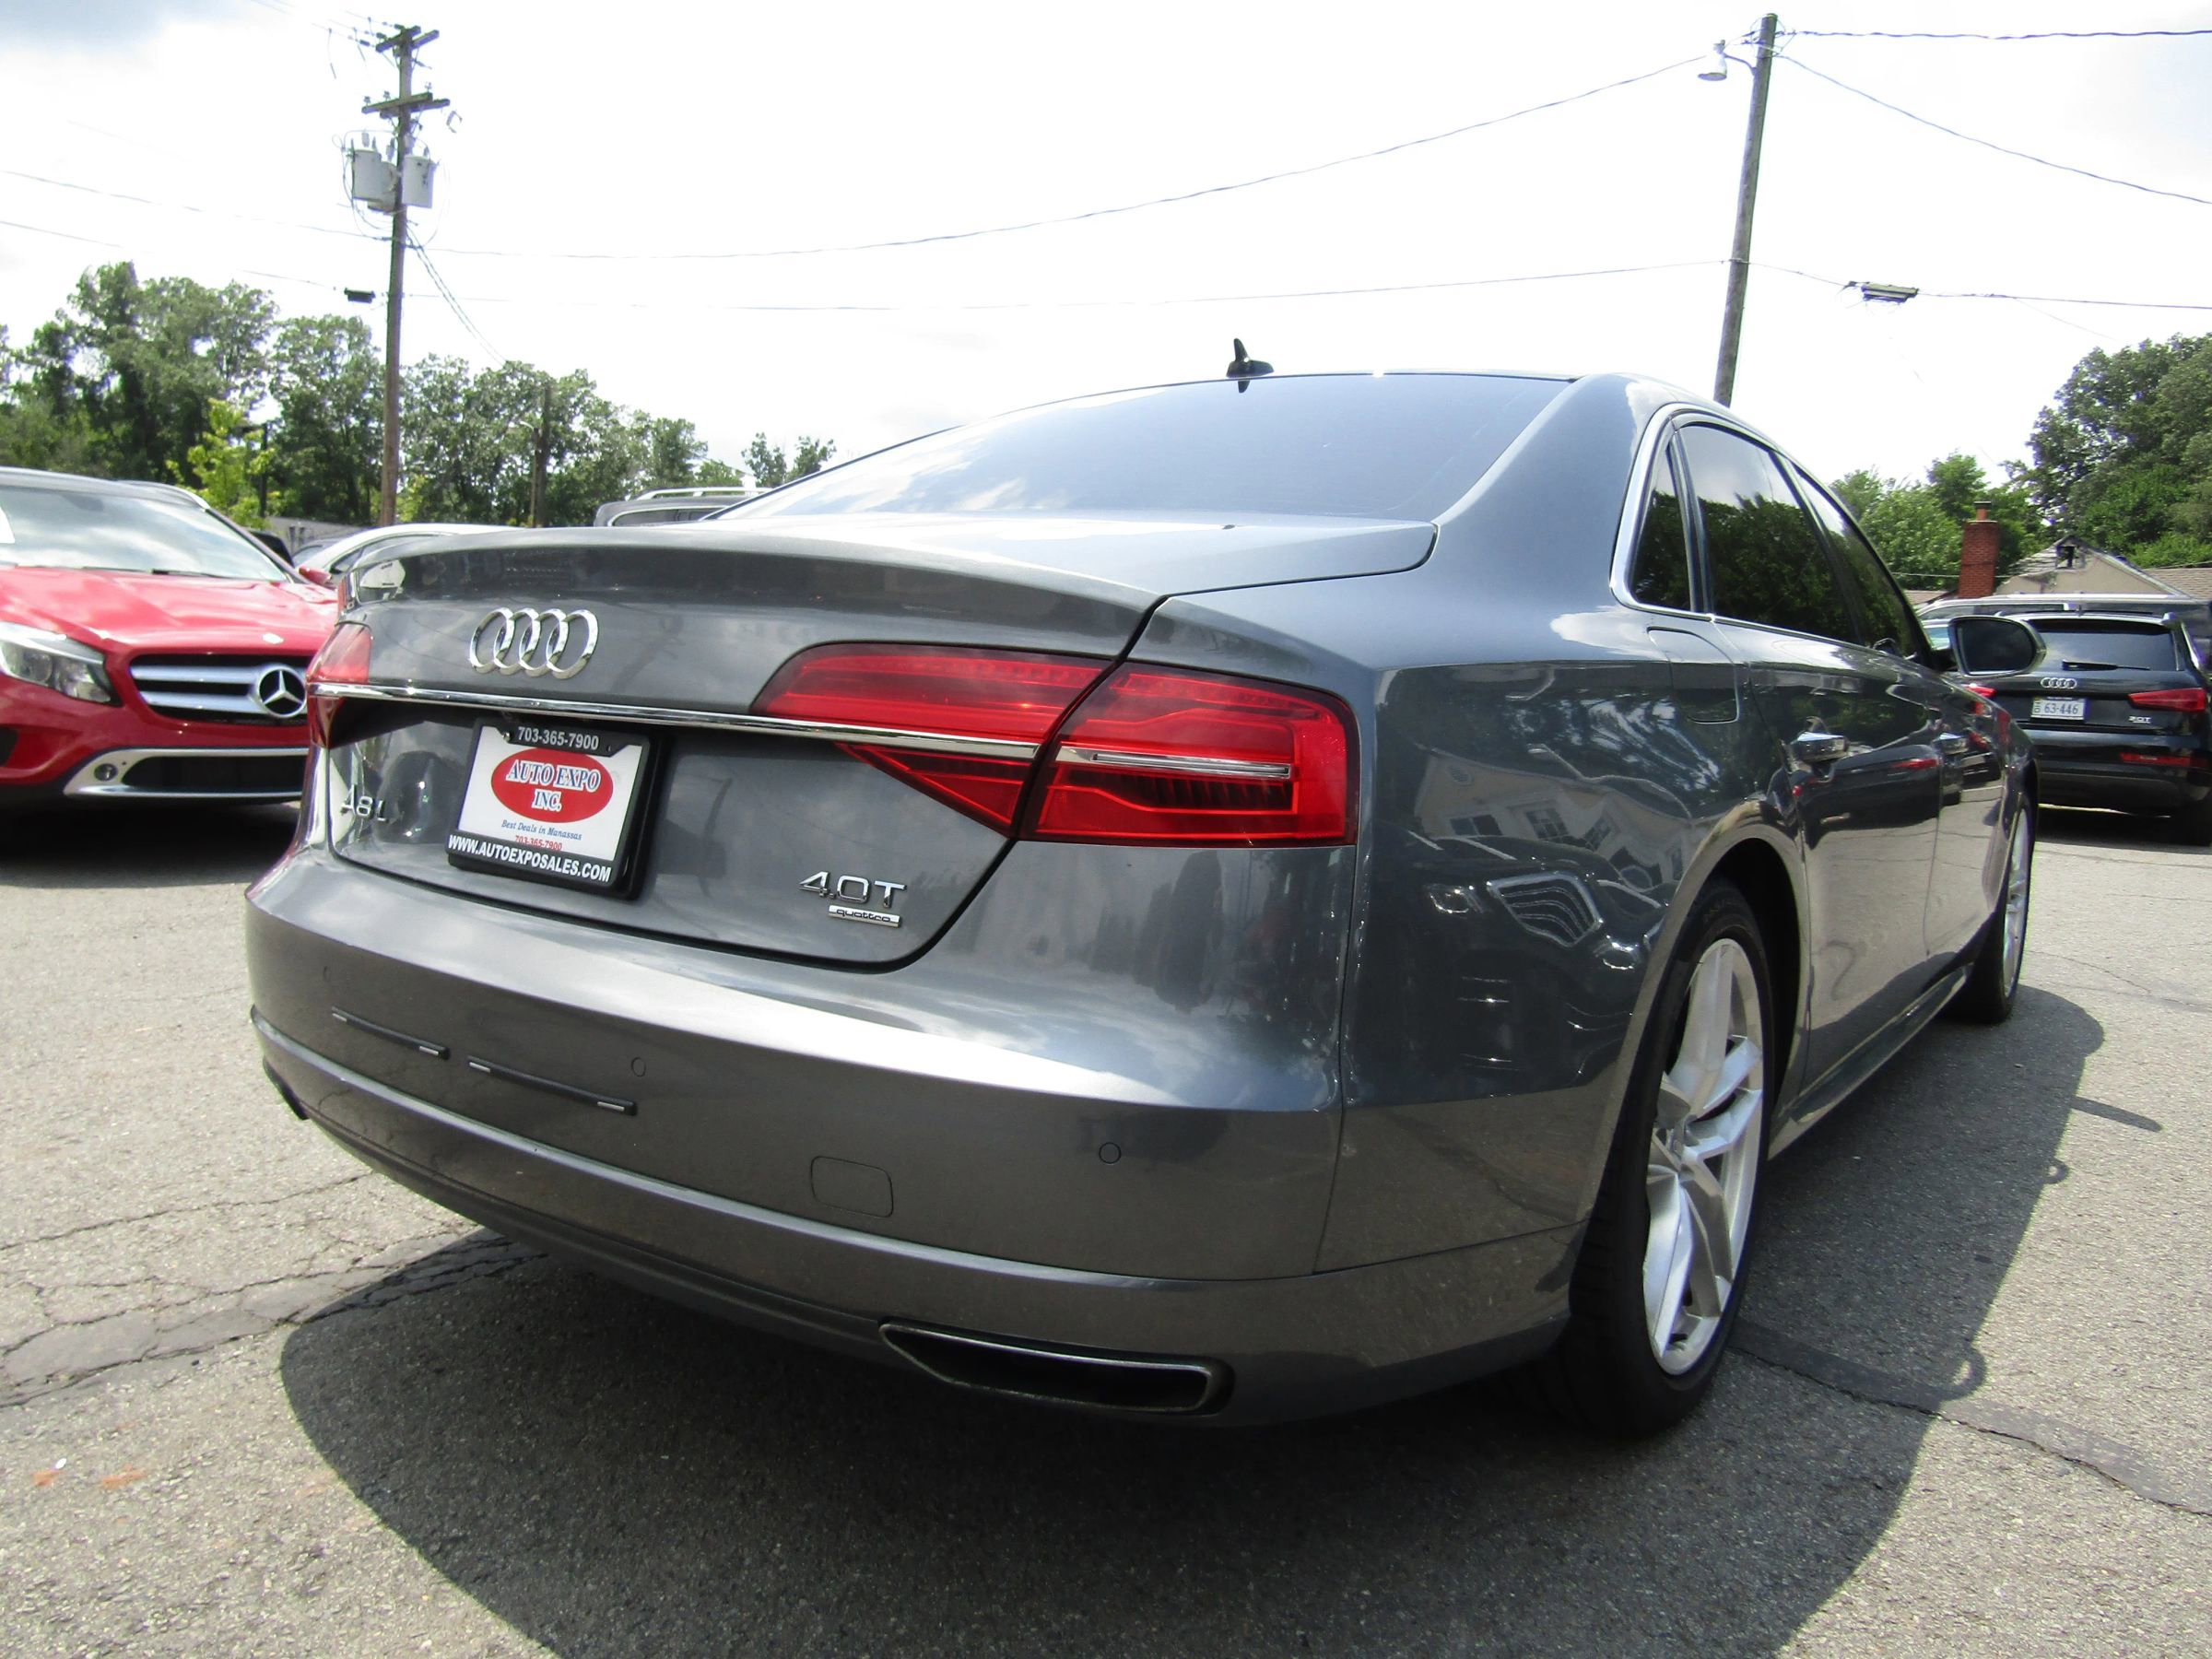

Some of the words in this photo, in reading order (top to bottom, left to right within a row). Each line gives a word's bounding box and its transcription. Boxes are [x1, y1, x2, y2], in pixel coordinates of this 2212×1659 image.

[2043, 702, 2078, 714] 63-446
[517, 726, 599, 750] 703-365-7900
[506, 759, 554, 783] AUTO
[554, 765, 601, 793] EXPO
[340, 784, 386, 821] A8L
[532, 790, 562, 811] INC.
[501, 819, 516, 830] Best
[518, 822, 536, 833] Deals
[538, 825, 546, 834] in
[547, 827, 582, 841] Manassas
[515, 835, 562, 851] 703-365-7900
[448, 834, 612, 882] WWW.AUTOEXPOSALES.COM
[799, 871, 907, 909] 4.0T
[835, 908, 892, 923] quattro
